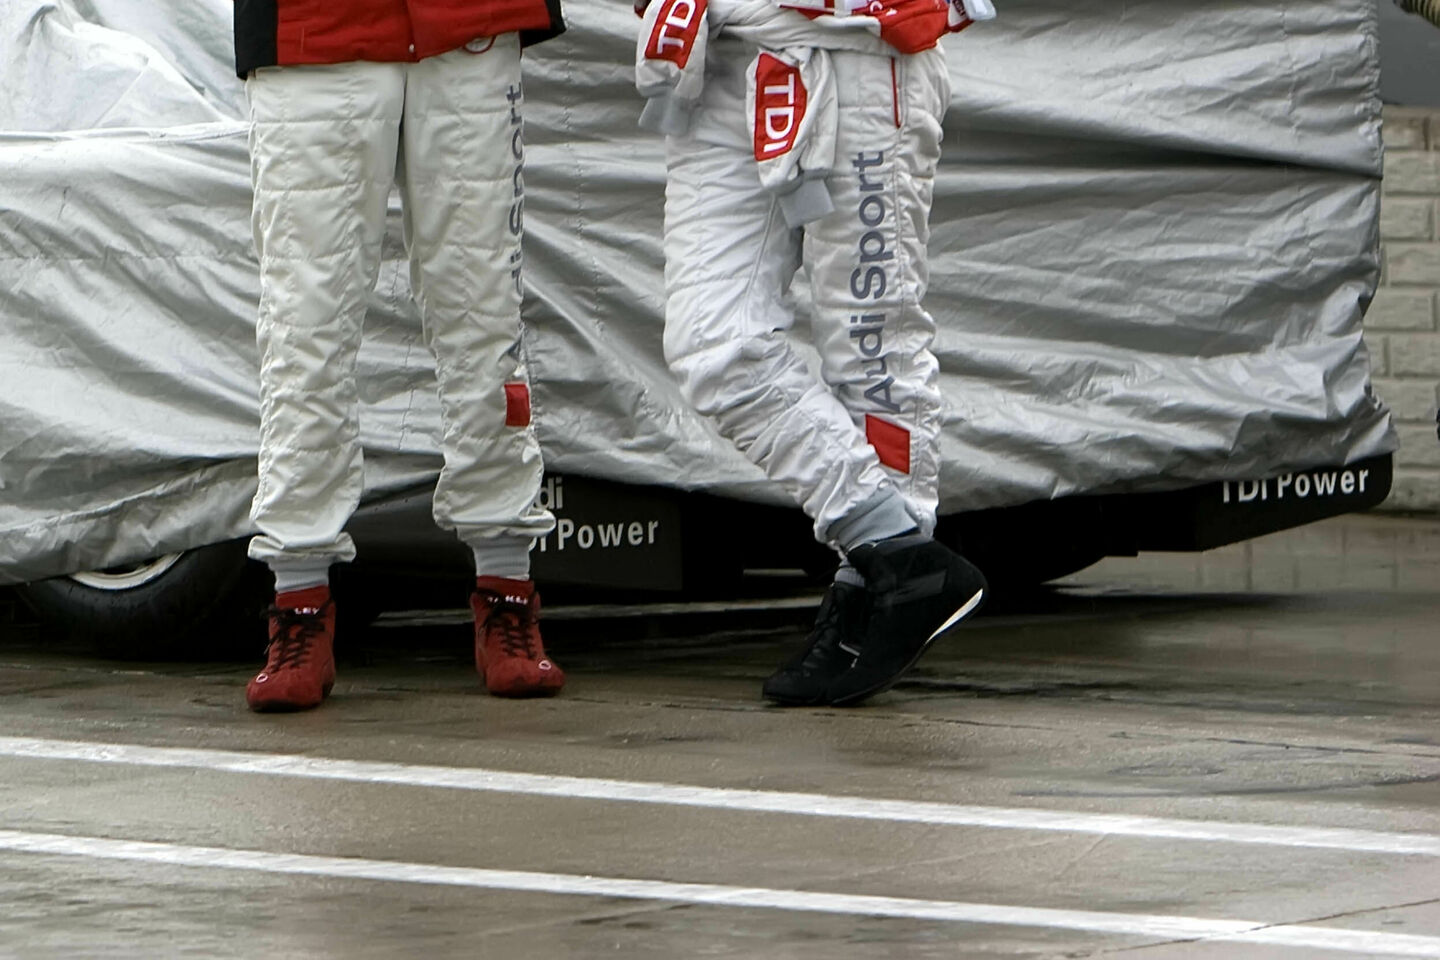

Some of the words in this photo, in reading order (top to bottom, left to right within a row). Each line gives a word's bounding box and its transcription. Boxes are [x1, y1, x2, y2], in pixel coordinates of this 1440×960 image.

[763, 73, 795, 153] TDI
[850, 151, 895, 300] Sport
[850, 314, 901, 413] Audi
[1277, 469, 1369, 499] Power
[557, 518, 659, 551] Power
